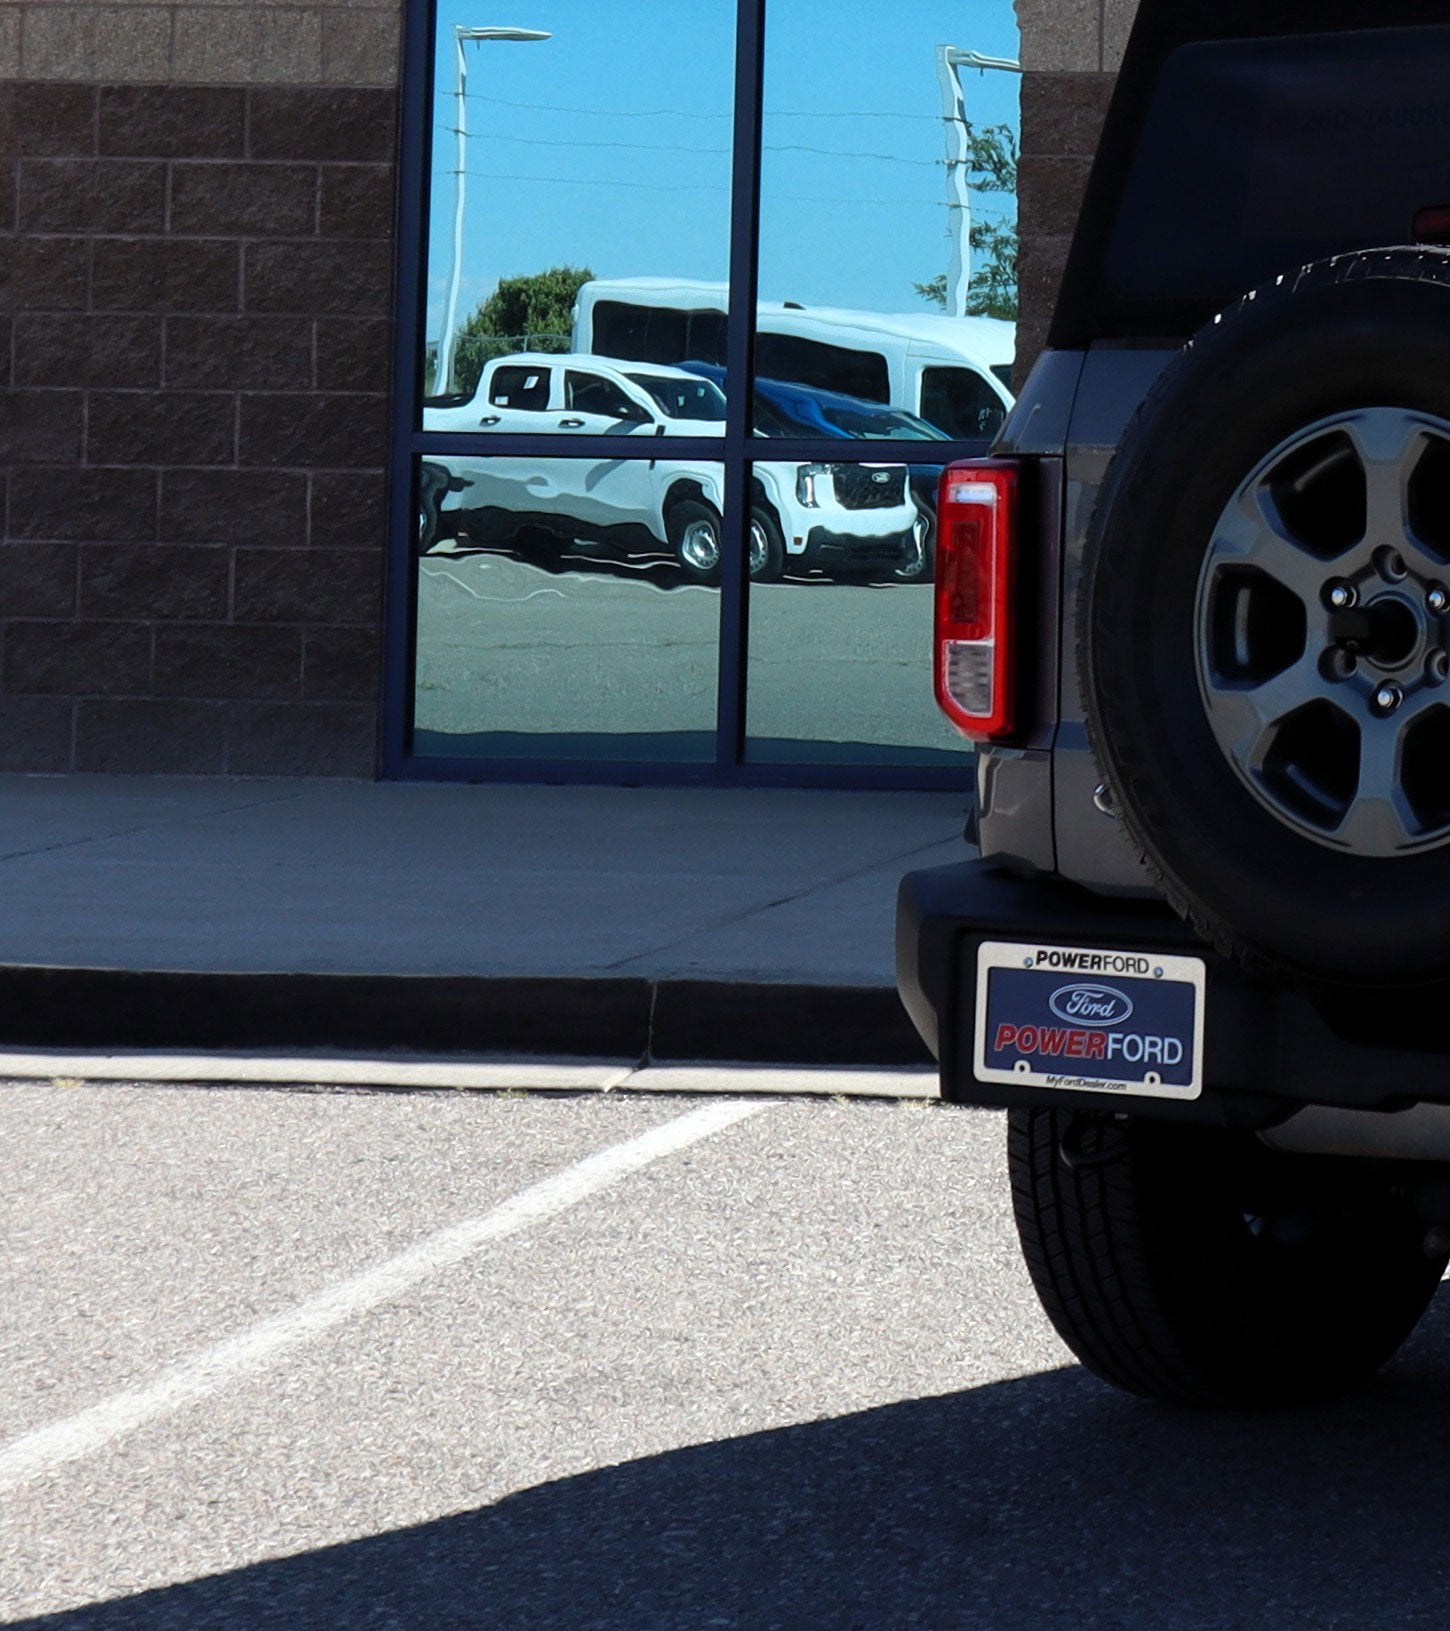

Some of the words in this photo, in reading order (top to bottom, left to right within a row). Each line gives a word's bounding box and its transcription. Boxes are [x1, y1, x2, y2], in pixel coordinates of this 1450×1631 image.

[1036, 950, 1149, 974] POWERFORD
[1066, 990, 1116, 1018] Ford
[994, 1023, 1183, 1065] POWERFORD
